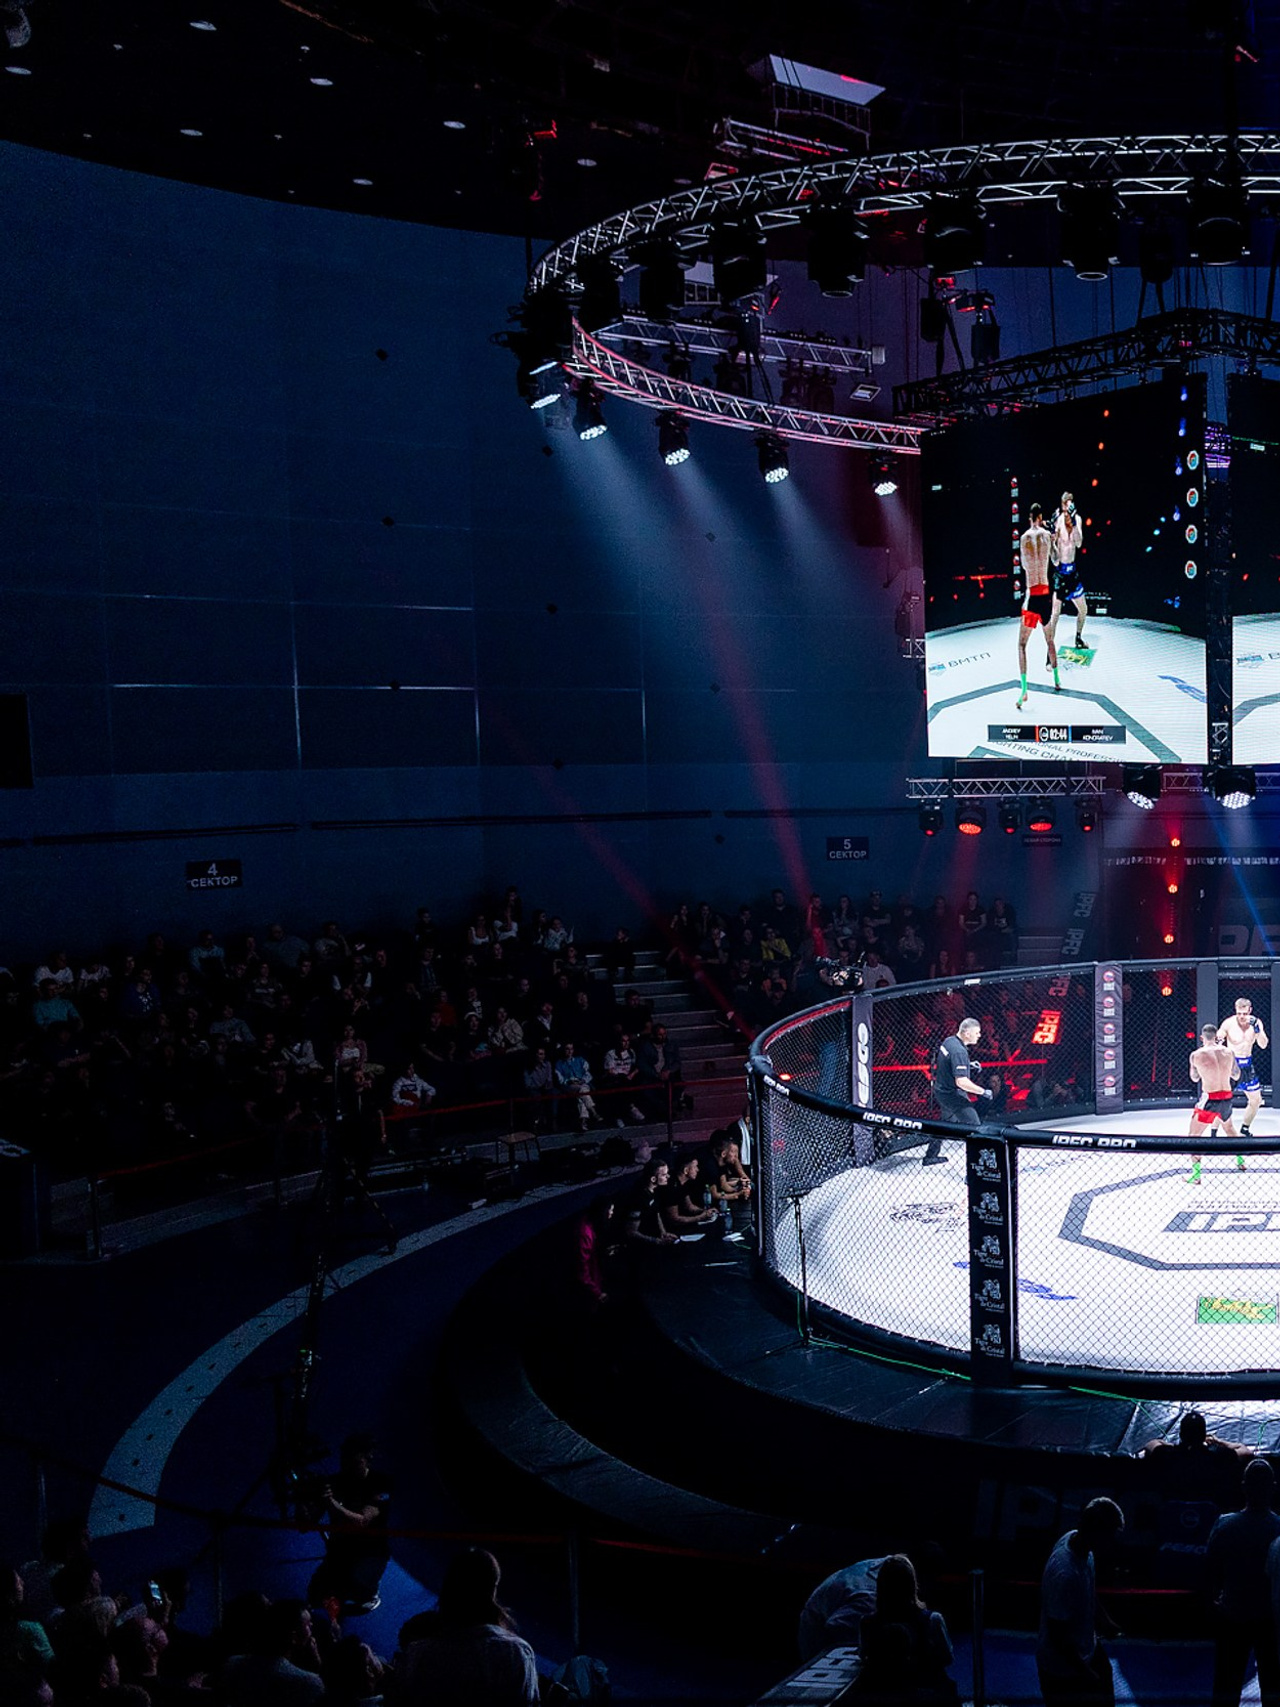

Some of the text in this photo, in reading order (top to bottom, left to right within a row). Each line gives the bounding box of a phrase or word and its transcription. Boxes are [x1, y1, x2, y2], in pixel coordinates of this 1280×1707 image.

[843, 838, 852, 850] 5
[829, 850, 867, 859] СЕКТОР
[207, 862, 218, 876] 4
[190, 876, 238, 888] СЕКТОР
[1061, 928, 1085, 955] IPFC
